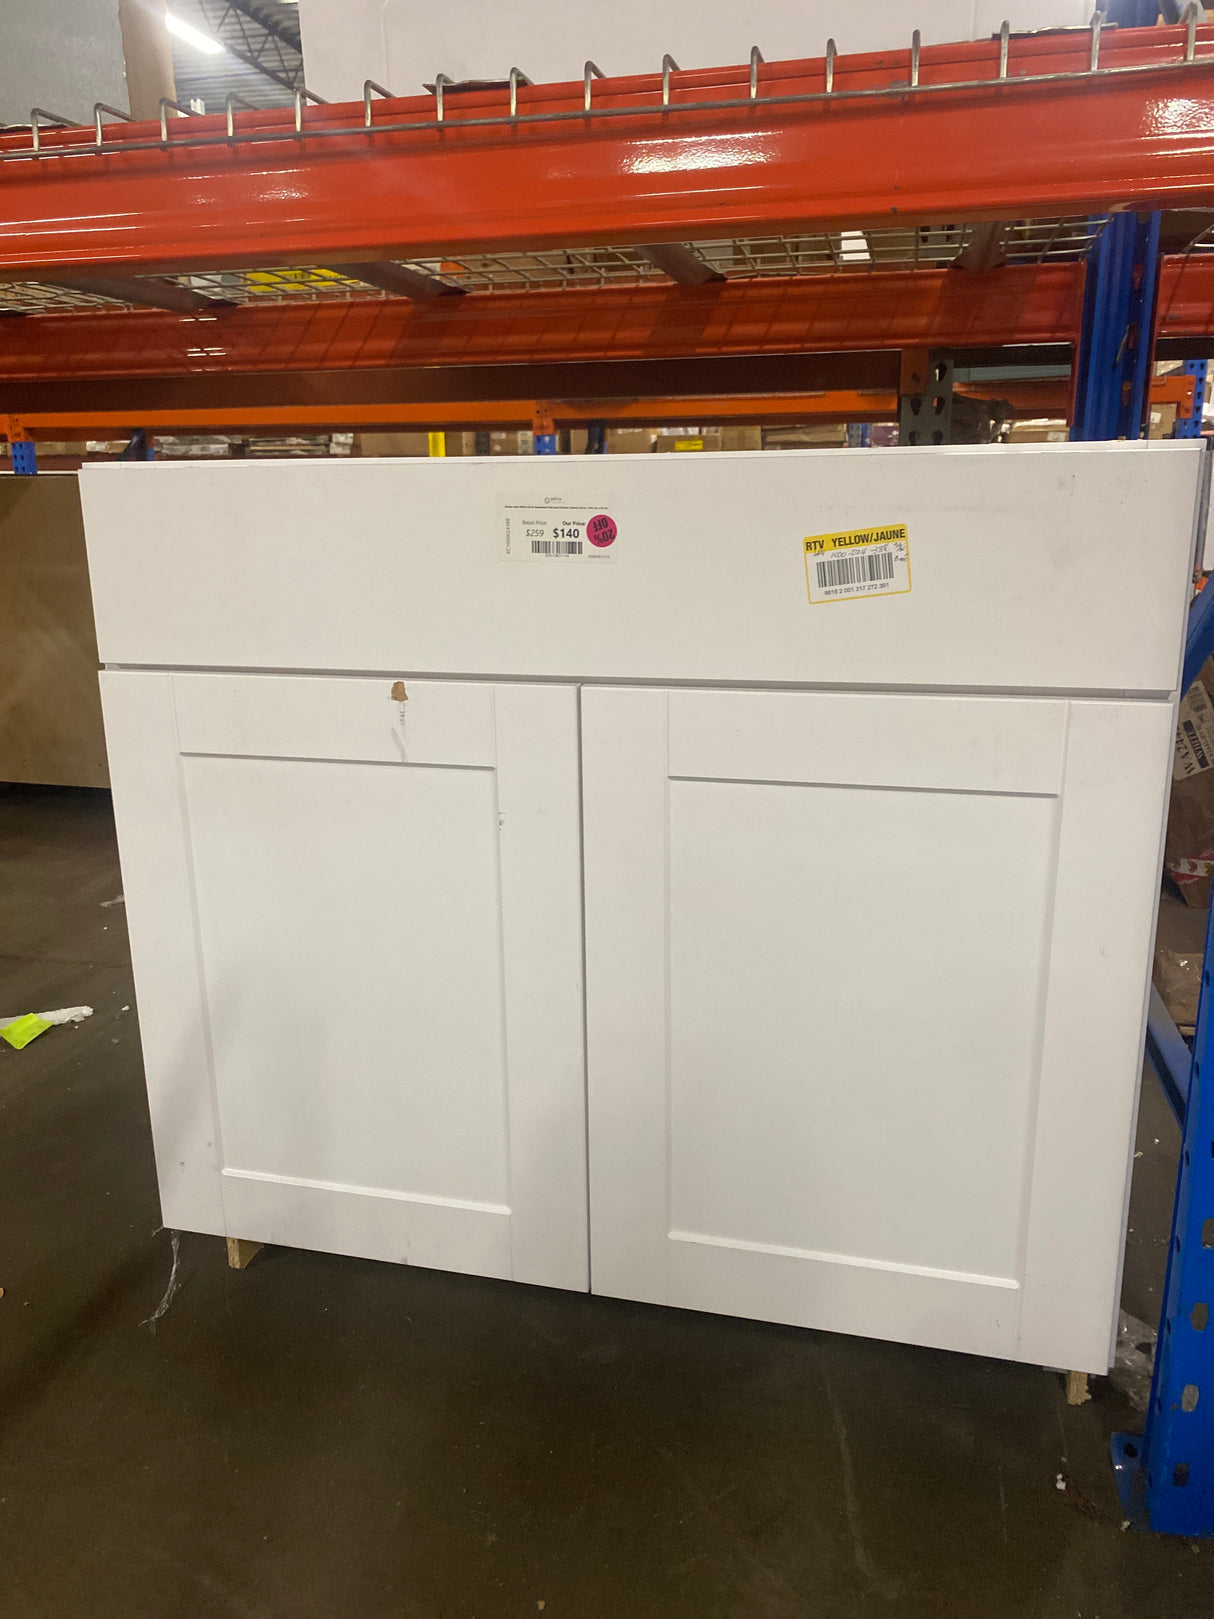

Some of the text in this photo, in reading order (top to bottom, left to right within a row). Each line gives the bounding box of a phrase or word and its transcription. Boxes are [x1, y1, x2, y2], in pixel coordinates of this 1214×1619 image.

[592, 517, 609, 532] OFF
[526, 529, 544, 537] $259
[553, 527, 580, 539] $140
[593, 529, 615, 545] 20%
[805, 540, 825, 552] RTV
[831, 528, 906, 548] YELLOW/JAUNE
